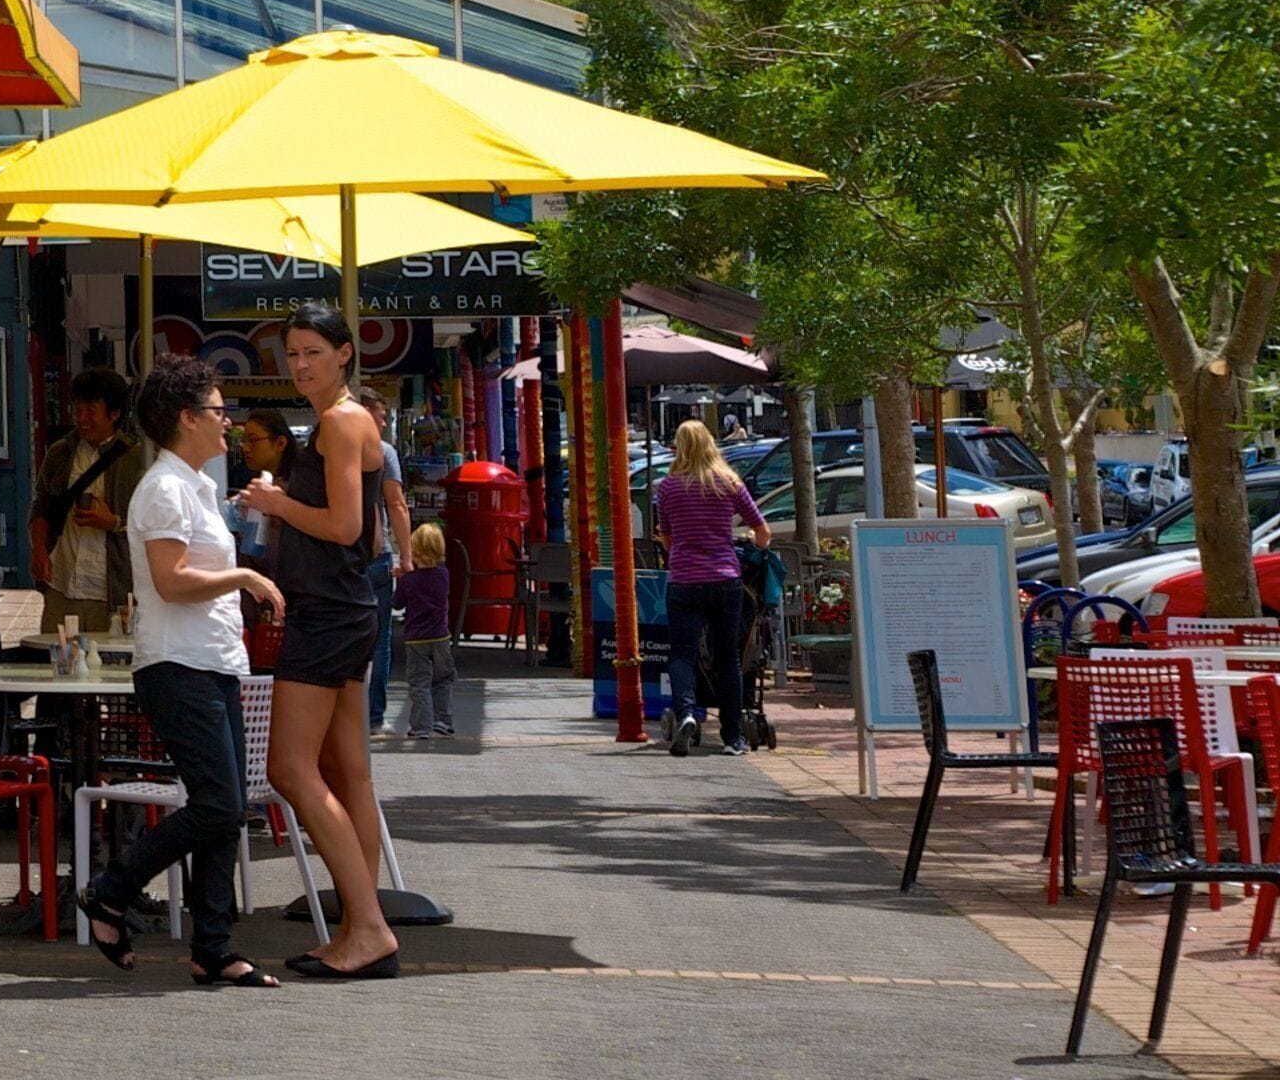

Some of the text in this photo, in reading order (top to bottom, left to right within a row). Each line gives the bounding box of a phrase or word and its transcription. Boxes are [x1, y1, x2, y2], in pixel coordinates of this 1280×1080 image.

[429, 295, 441, 310] &
[457, 294, 503, 309] BAR
[905, 530, 956, 544] LUNCH
